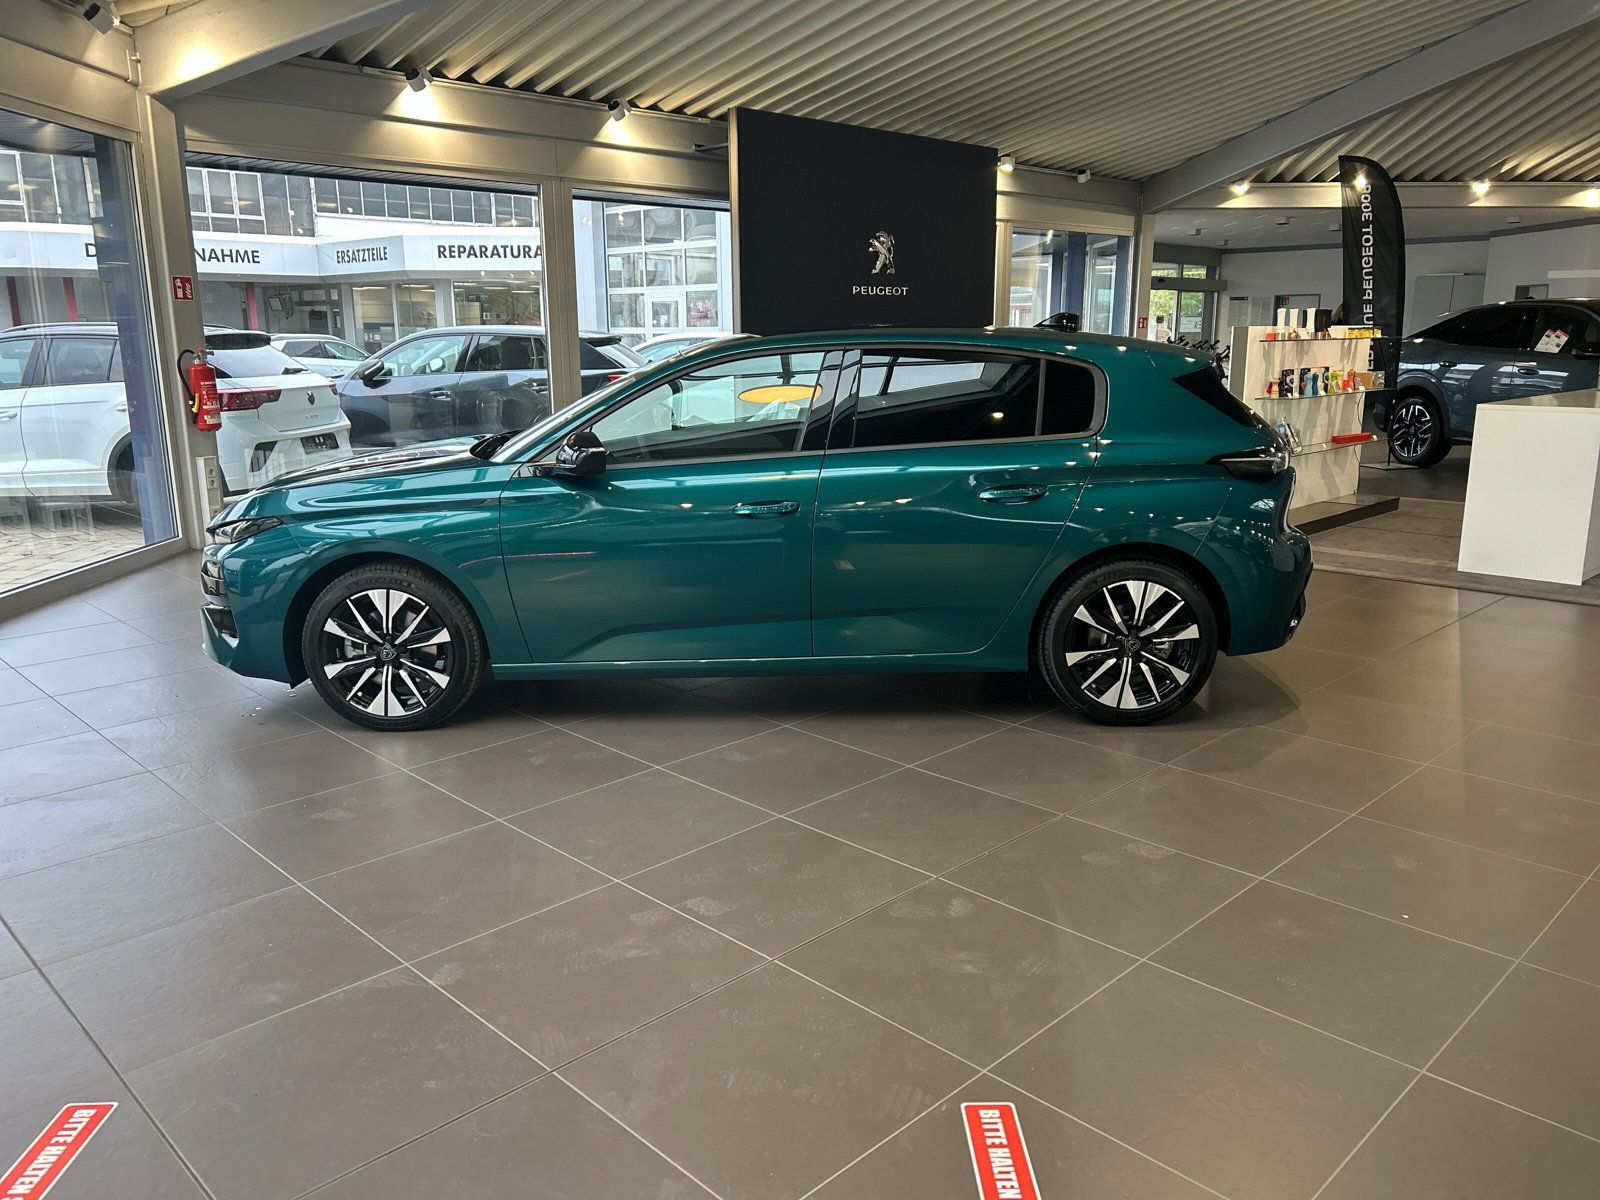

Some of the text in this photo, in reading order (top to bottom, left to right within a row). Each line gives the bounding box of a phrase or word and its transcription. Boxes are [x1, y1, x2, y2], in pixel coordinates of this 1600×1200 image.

[336, 246, 388, 264] ERSATZTEILE
[437, 245, 543, 259] REPARATURA
[852, 285, 909, 296] PEUGEOT
[50, 1109, 98, 1144] BITTE
[978, 1109, 1023, 1199] BITTE HALTEN
[6, 1145, 68, 1195] HALTEN
